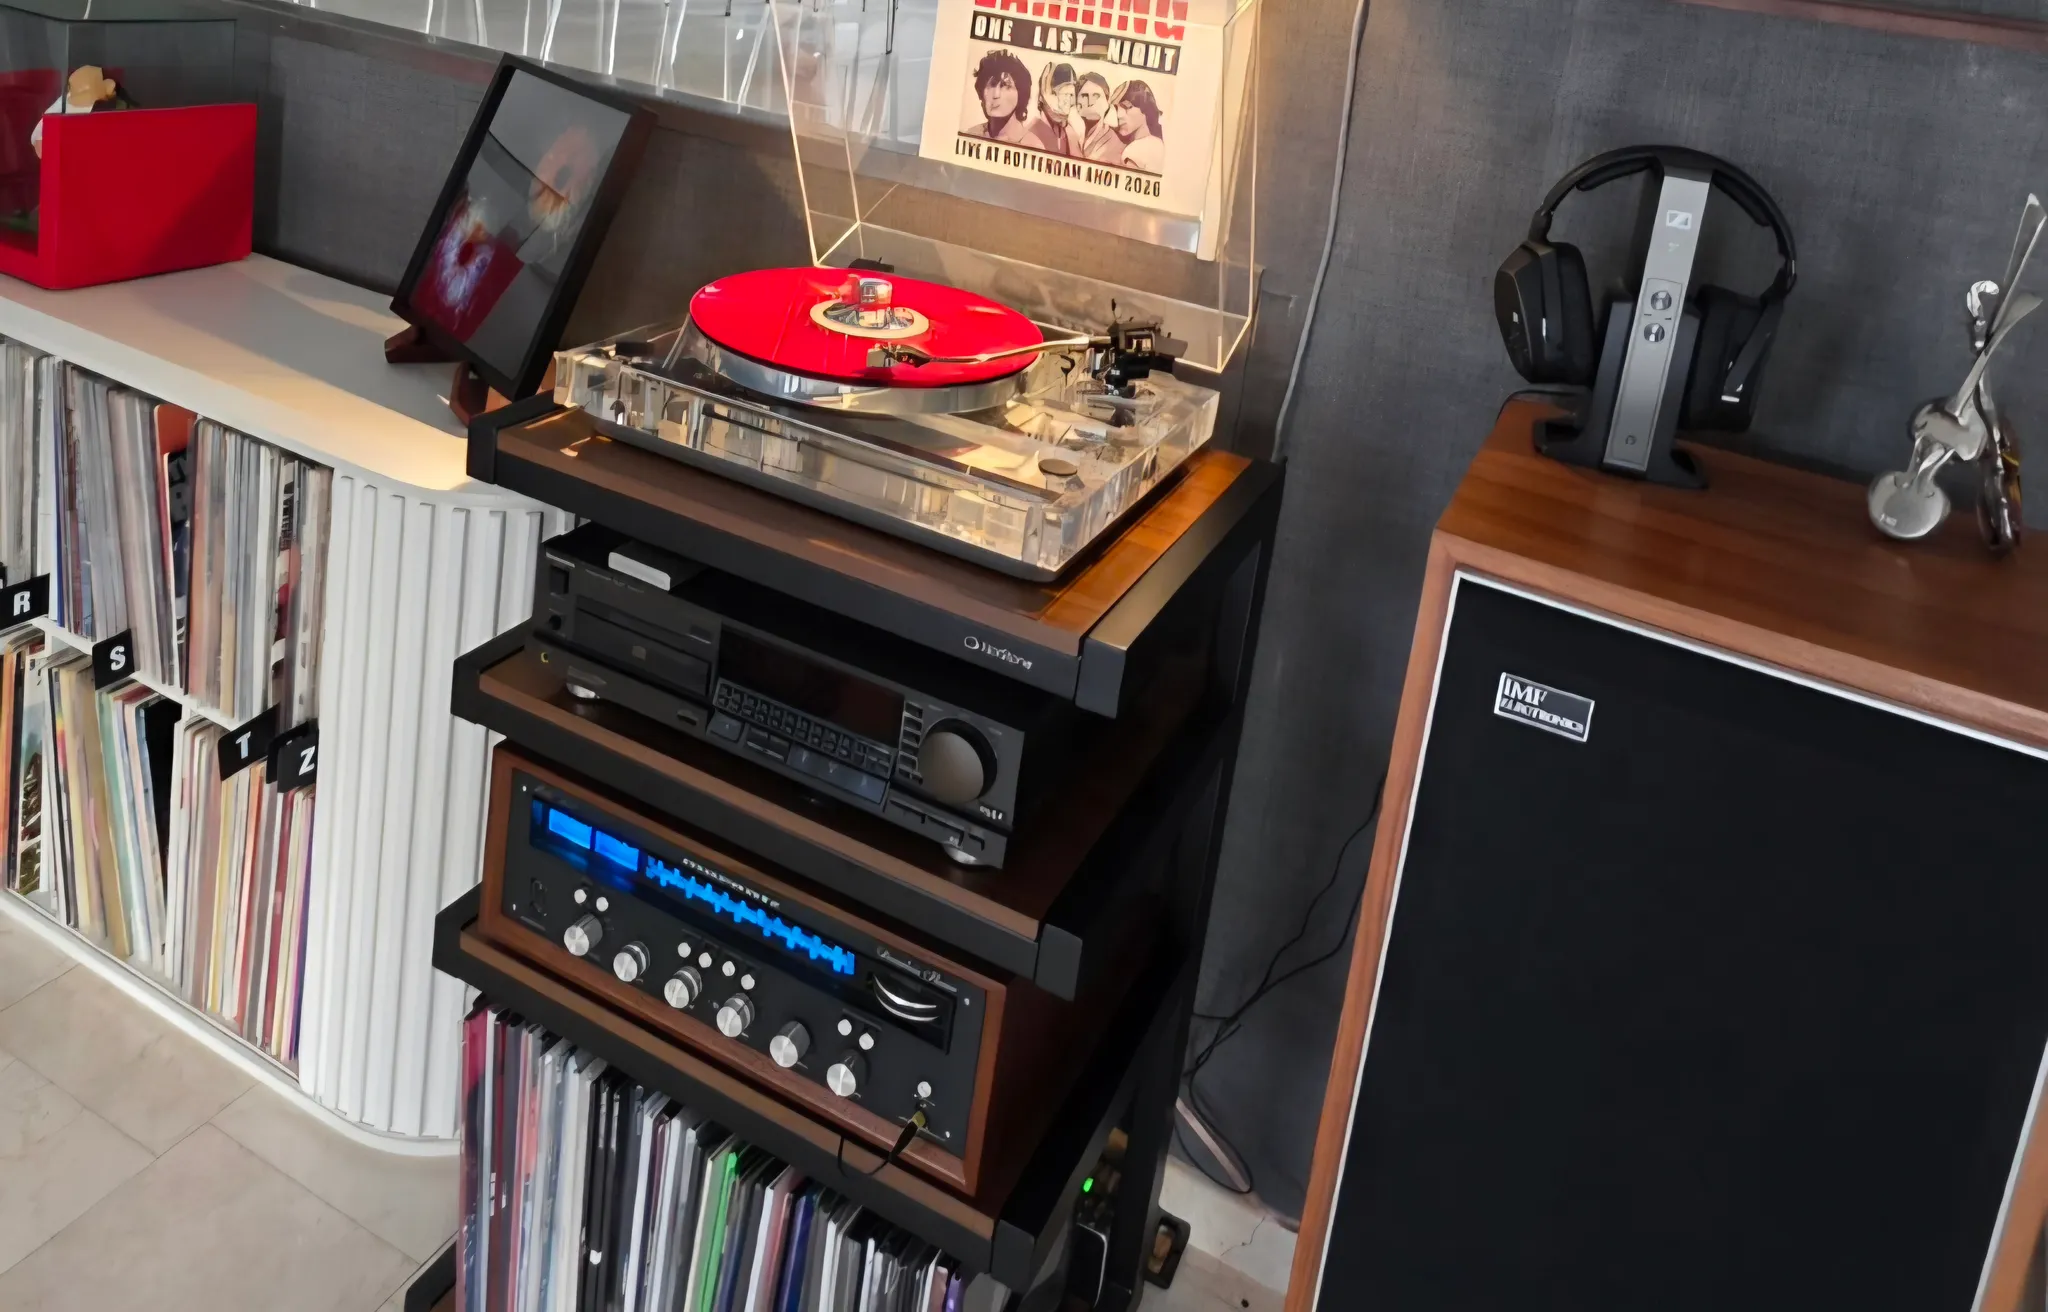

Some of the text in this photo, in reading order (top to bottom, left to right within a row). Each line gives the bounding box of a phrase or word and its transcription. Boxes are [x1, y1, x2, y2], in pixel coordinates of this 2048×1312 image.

[974, 14, 1014, 42] ONE
[1033, 25, 1087, 54] LAST
[955, 138, 981, 160] LIVE
[985, 145, 1000, 163] AT
[1004, 149, 1082, 180] ROTTERDAM
[13, 590, 31, 617] R
[109, 645, 126, 671] S
[1503, 677, 1548, 706] IMF
[235, 731, 252, 760] T
[298, 745, 316, 777] Z
